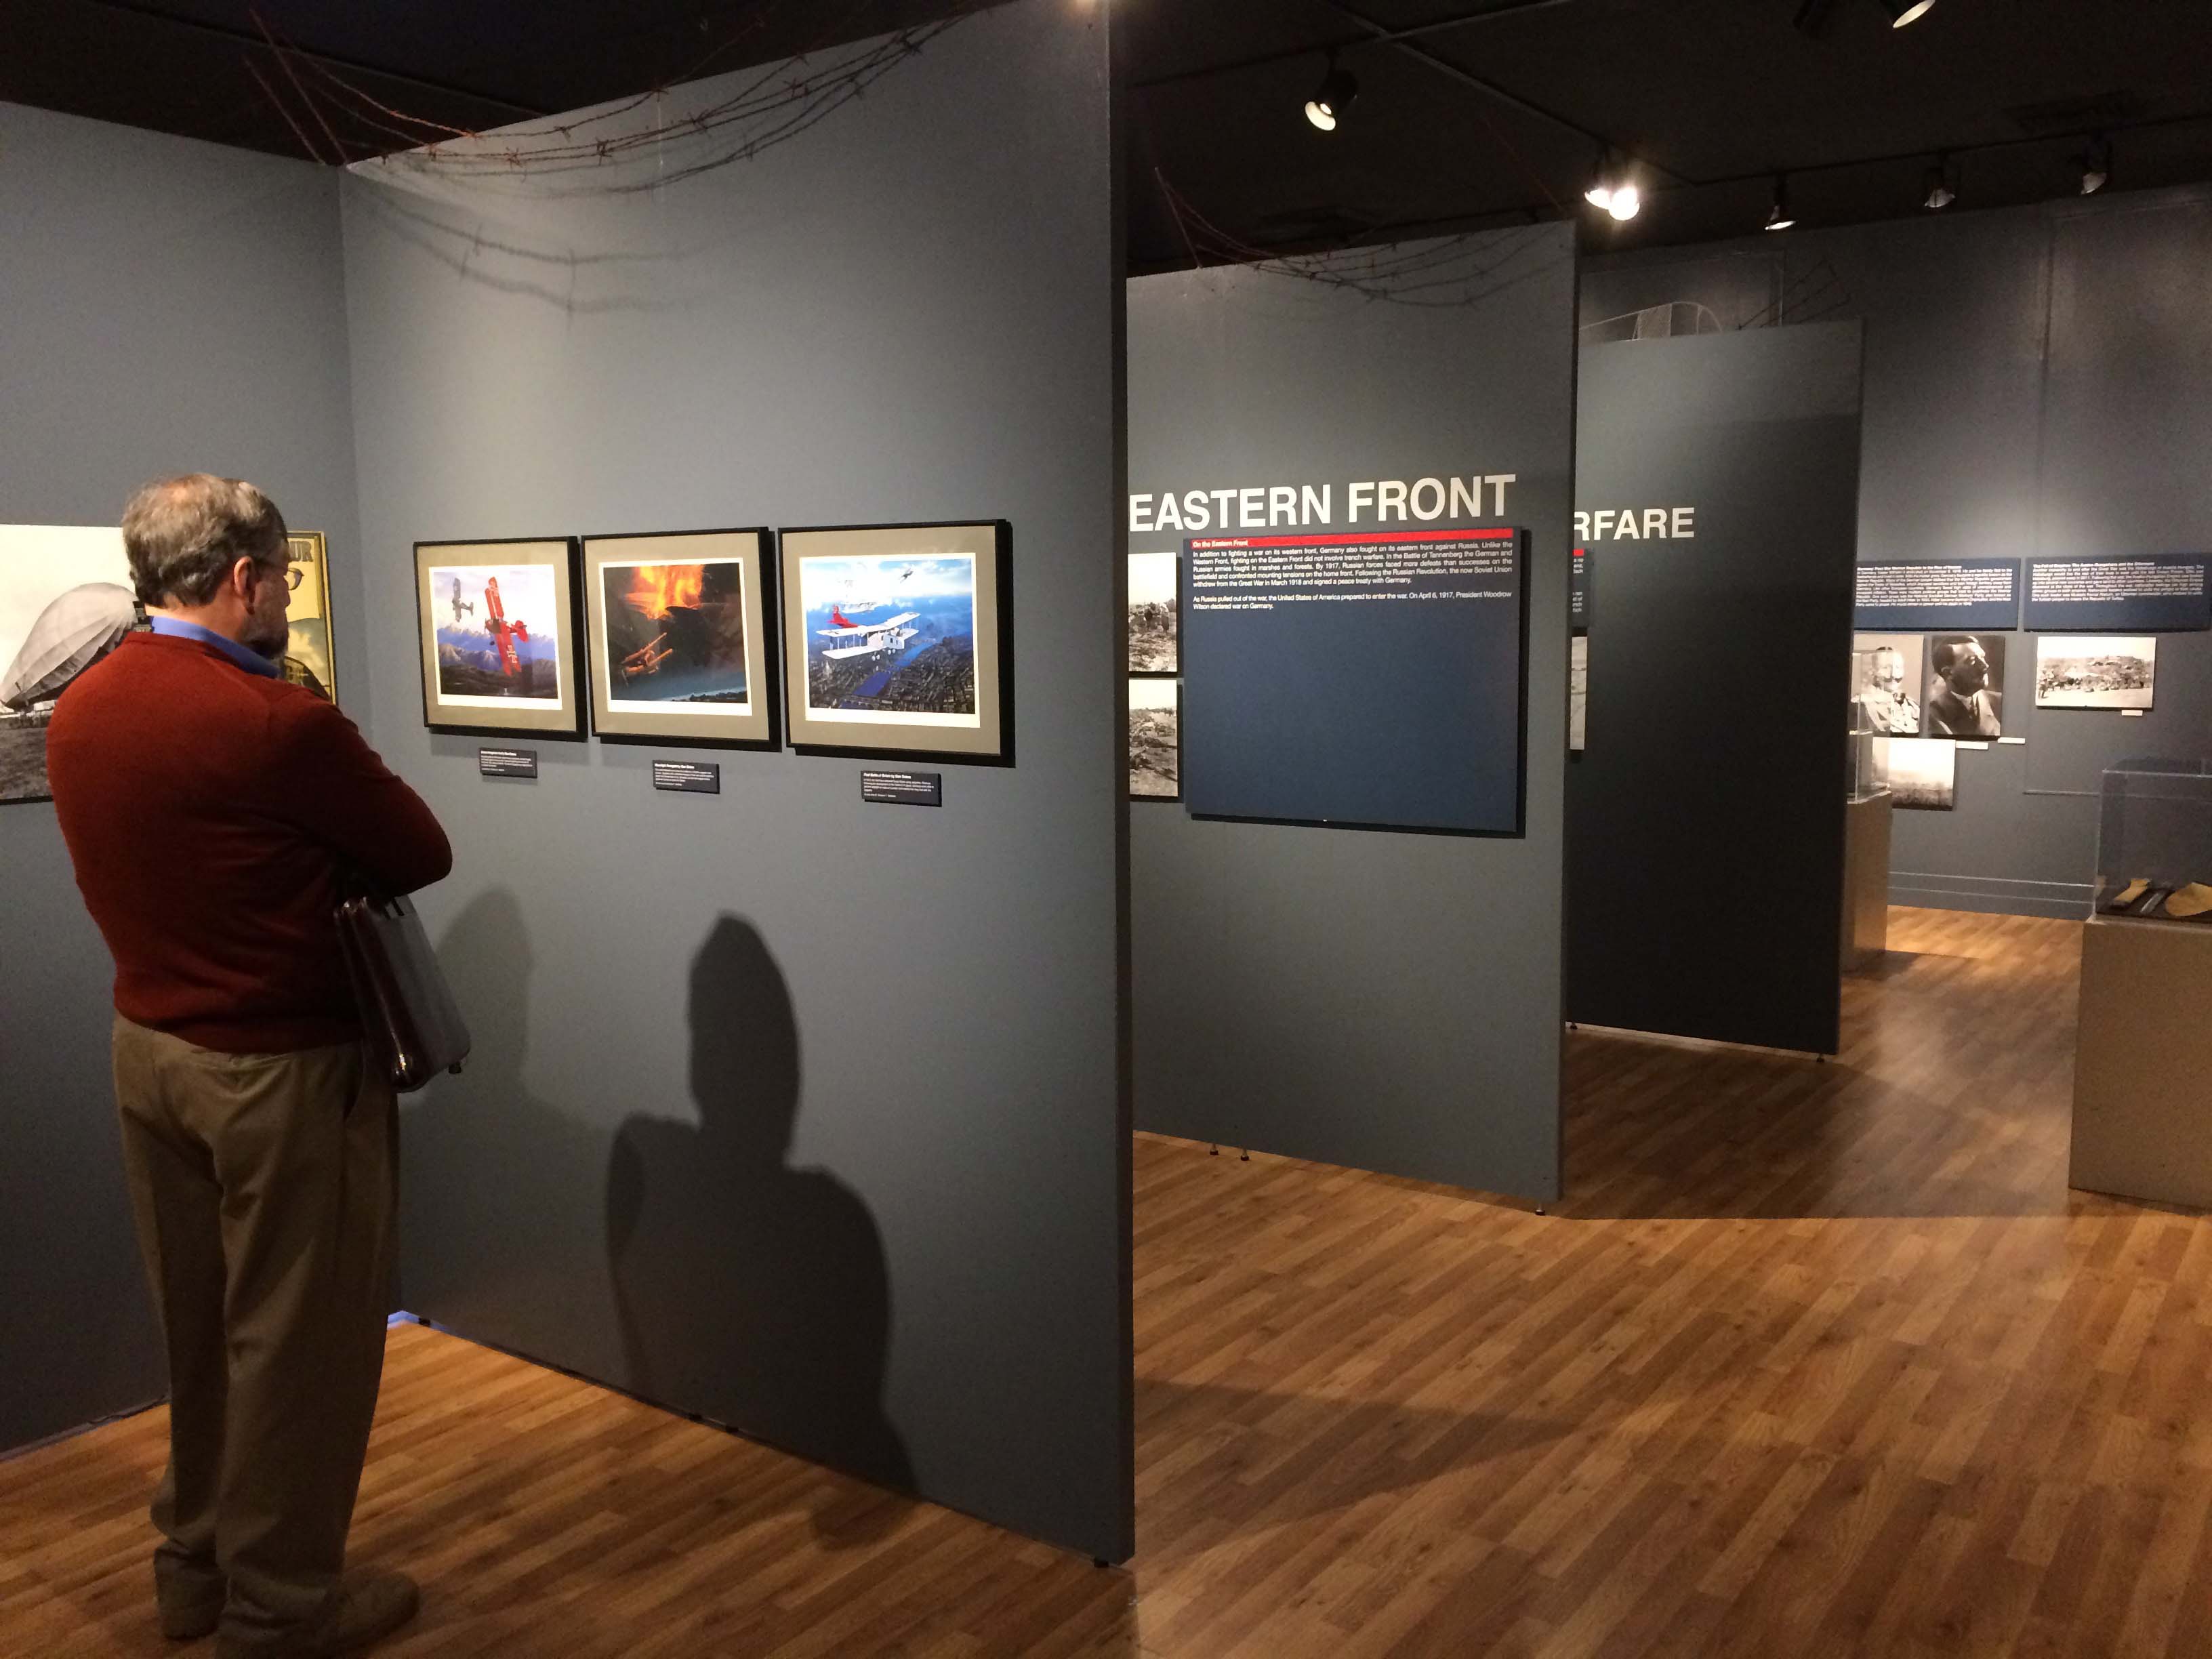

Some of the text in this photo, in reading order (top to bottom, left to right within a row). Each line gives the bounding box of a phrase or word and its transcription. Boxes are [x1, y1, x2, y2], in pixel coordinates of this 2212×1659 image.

[1129, 474, 1516, 532] EASTERN FRONT
[1574, 507, 1695, 541] RFARE
